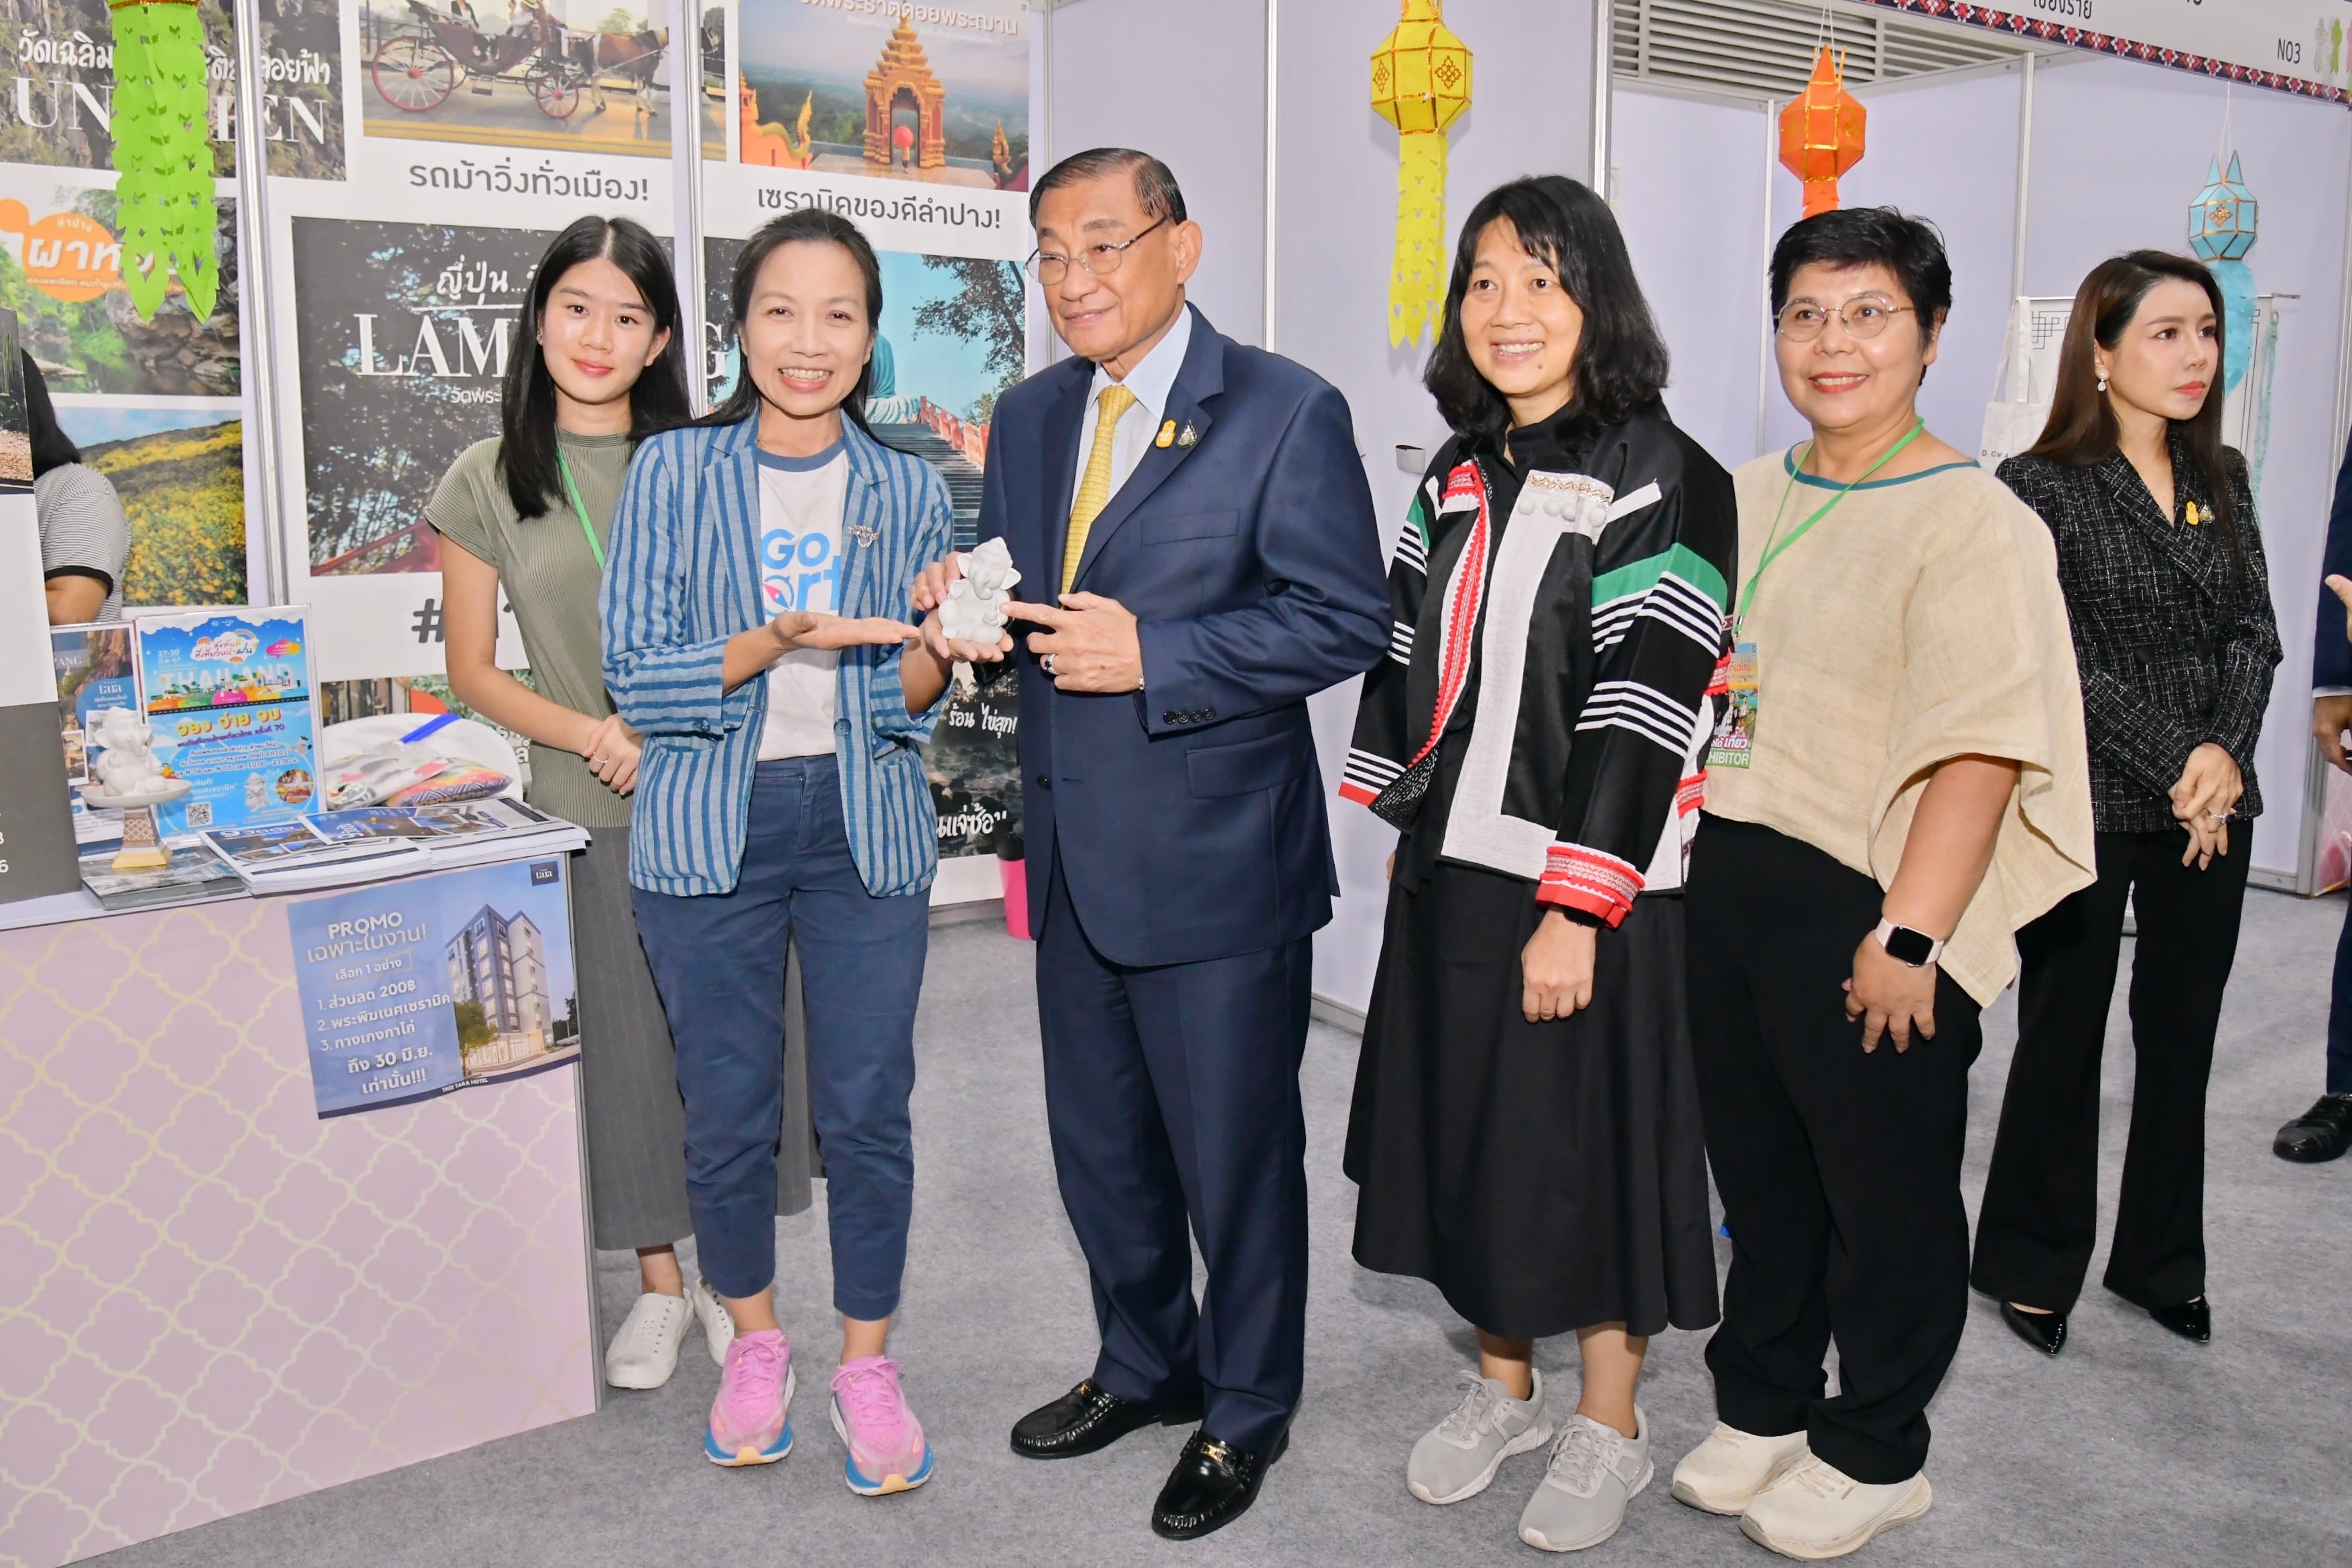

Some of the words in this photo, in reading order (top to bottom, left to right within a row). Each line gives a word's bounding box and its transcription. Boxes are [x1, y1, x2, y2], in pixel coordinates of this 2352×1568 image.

[1706, 751, 1750, 765] HIBITOR
[328, 911, 403, 939] PROMO
[375, 1052, 397, 1069] 30
